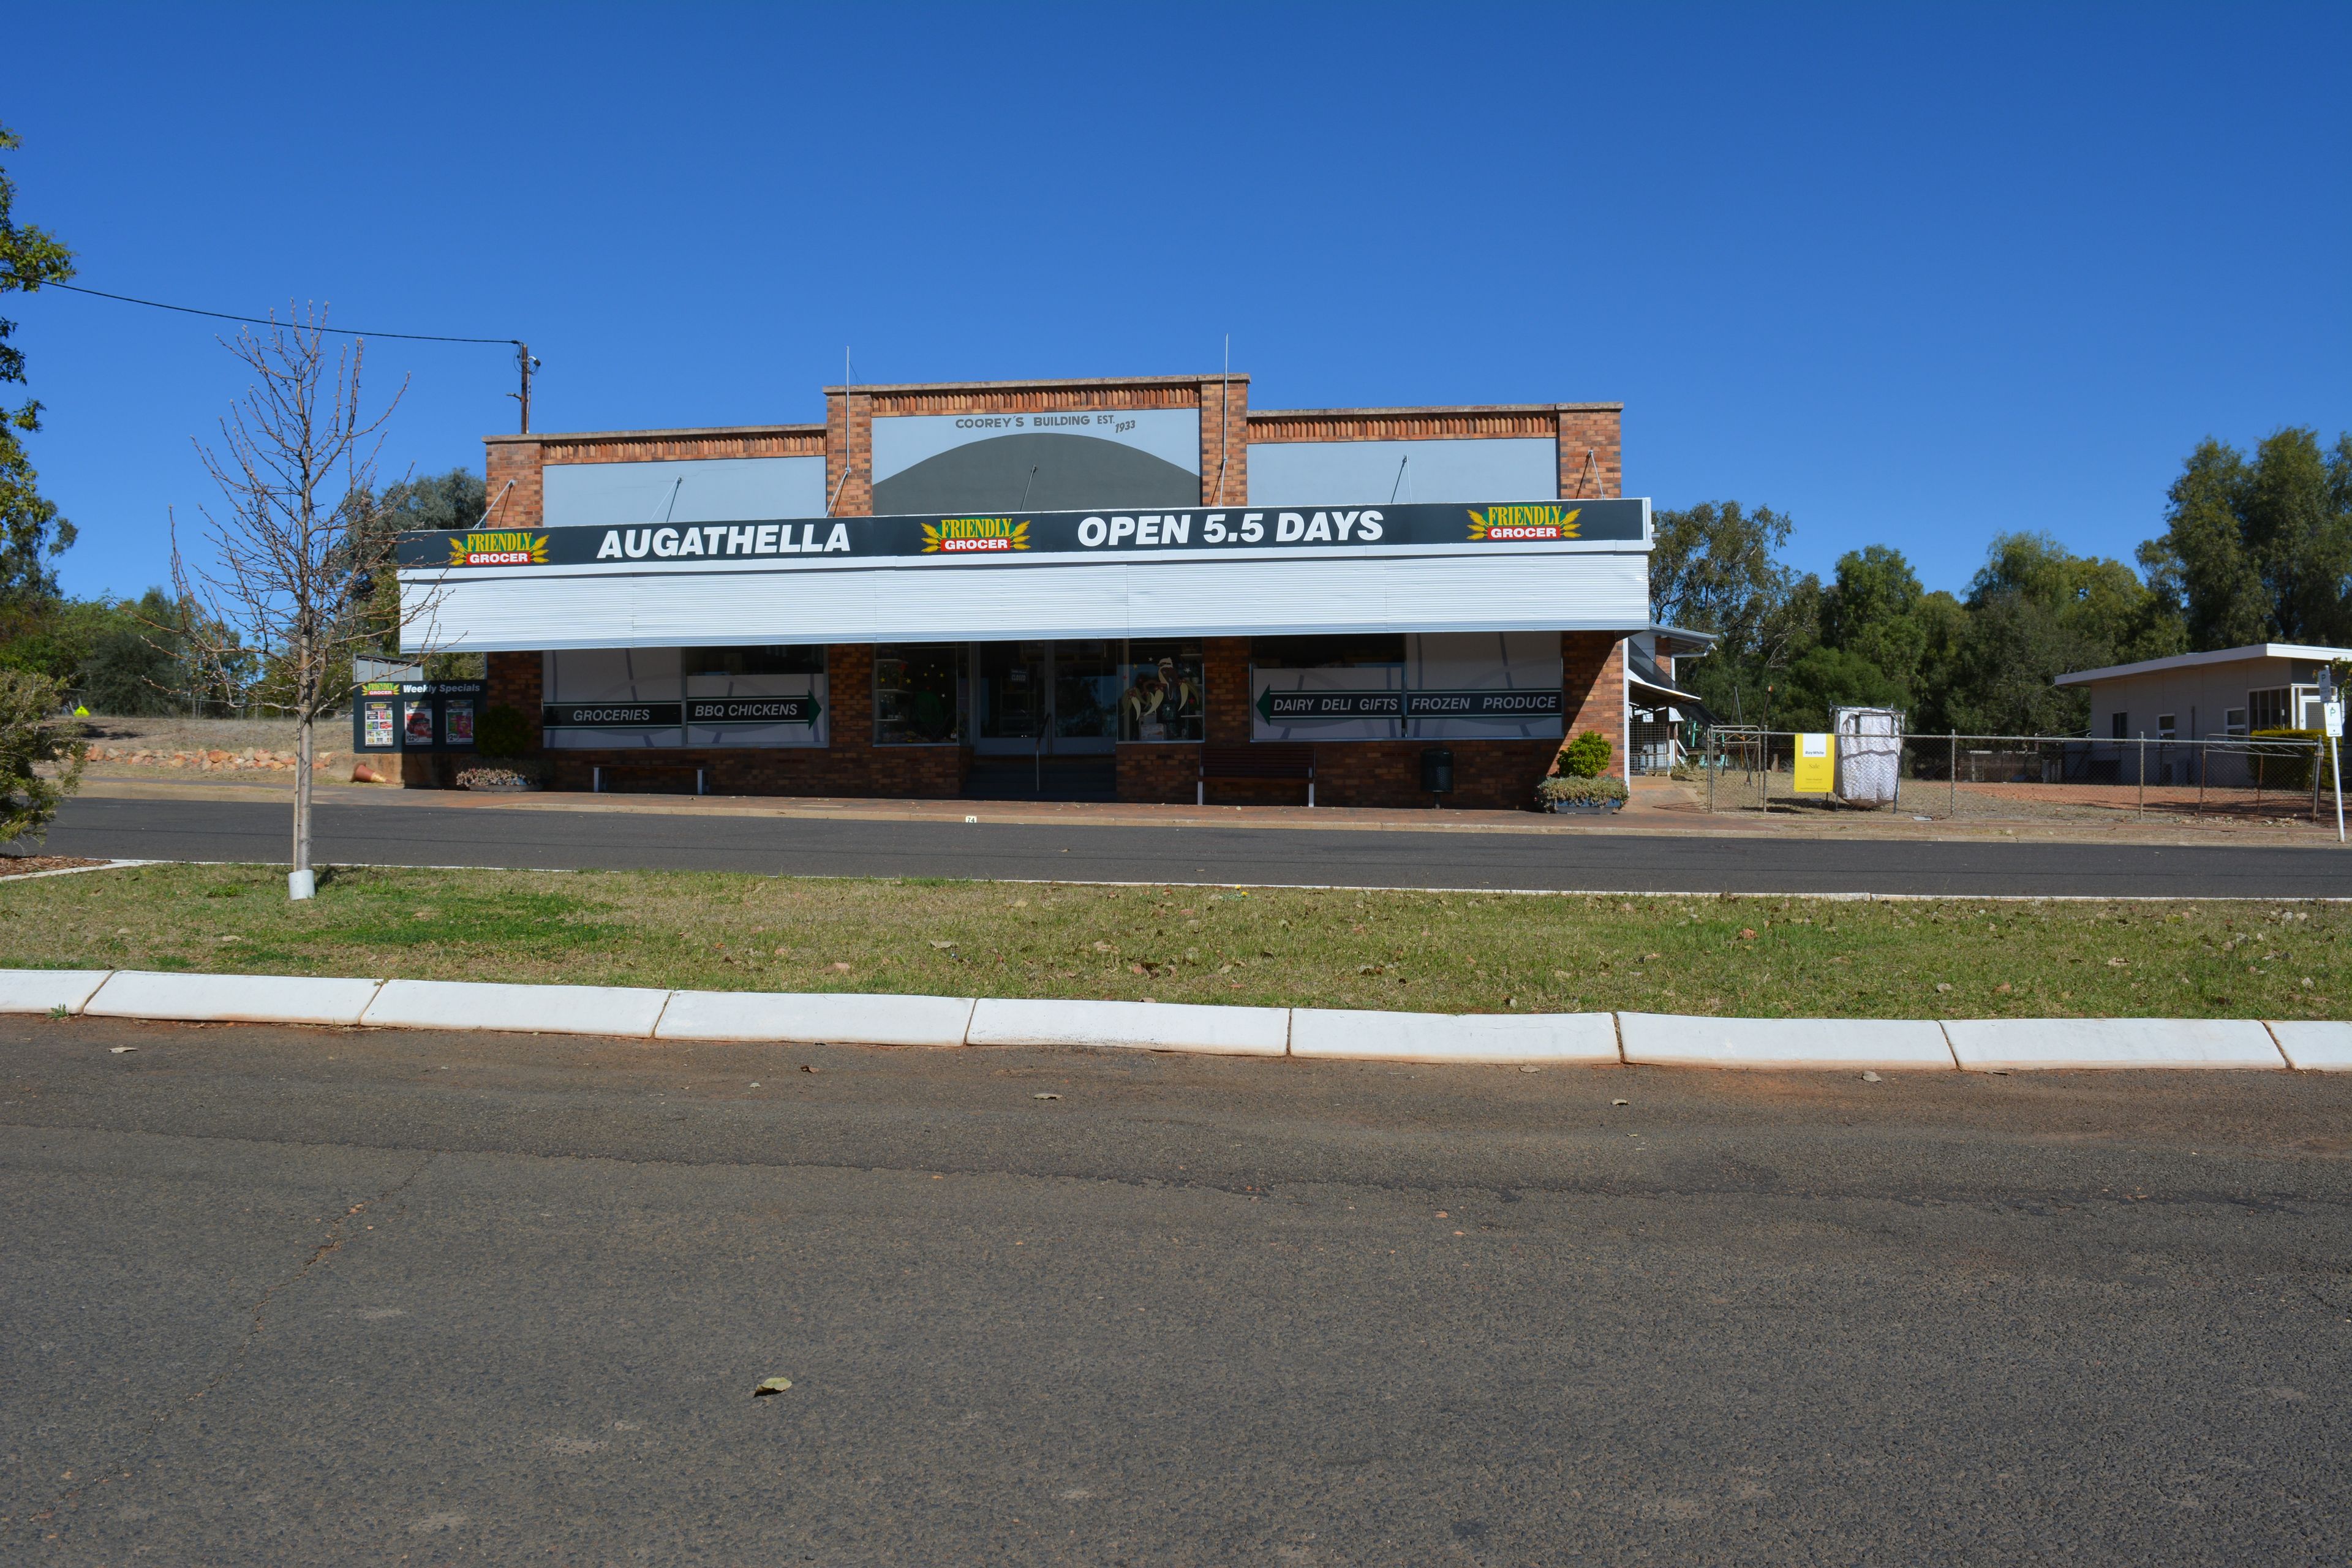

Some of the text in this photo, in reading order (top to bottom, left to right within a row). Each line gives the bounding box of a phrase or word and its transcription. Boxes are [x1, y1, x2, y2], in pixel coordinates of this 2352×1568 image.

[956, 415, 1136, 433] COOREY'S BUILDING EST. 1933
[1488, 505, 1562, 526] FRIENDLY
[941, 518, 1012, 538] FRIENDLY
[1077, 510, 1384, 546] OPEN 5.5 DAYS
[1491, 527, 1557, 538] GROCER
[467, 533, 532, 551] FRIENDLY
[597, 523, 850, 559] AUGATHELLA
[944, 539, 1008, 549] GROCER
[469, 553, 528, 563] GROCER
[403, 684, 480, 694] Weekly Specials
[1273, 696, 1557, 710] DAIRY DELI GIFTS FROZEN PRODUCE
[573, 709, 650, 722] GROCERIES
[695, 704, 798, 717] BBQ CHICKENS
